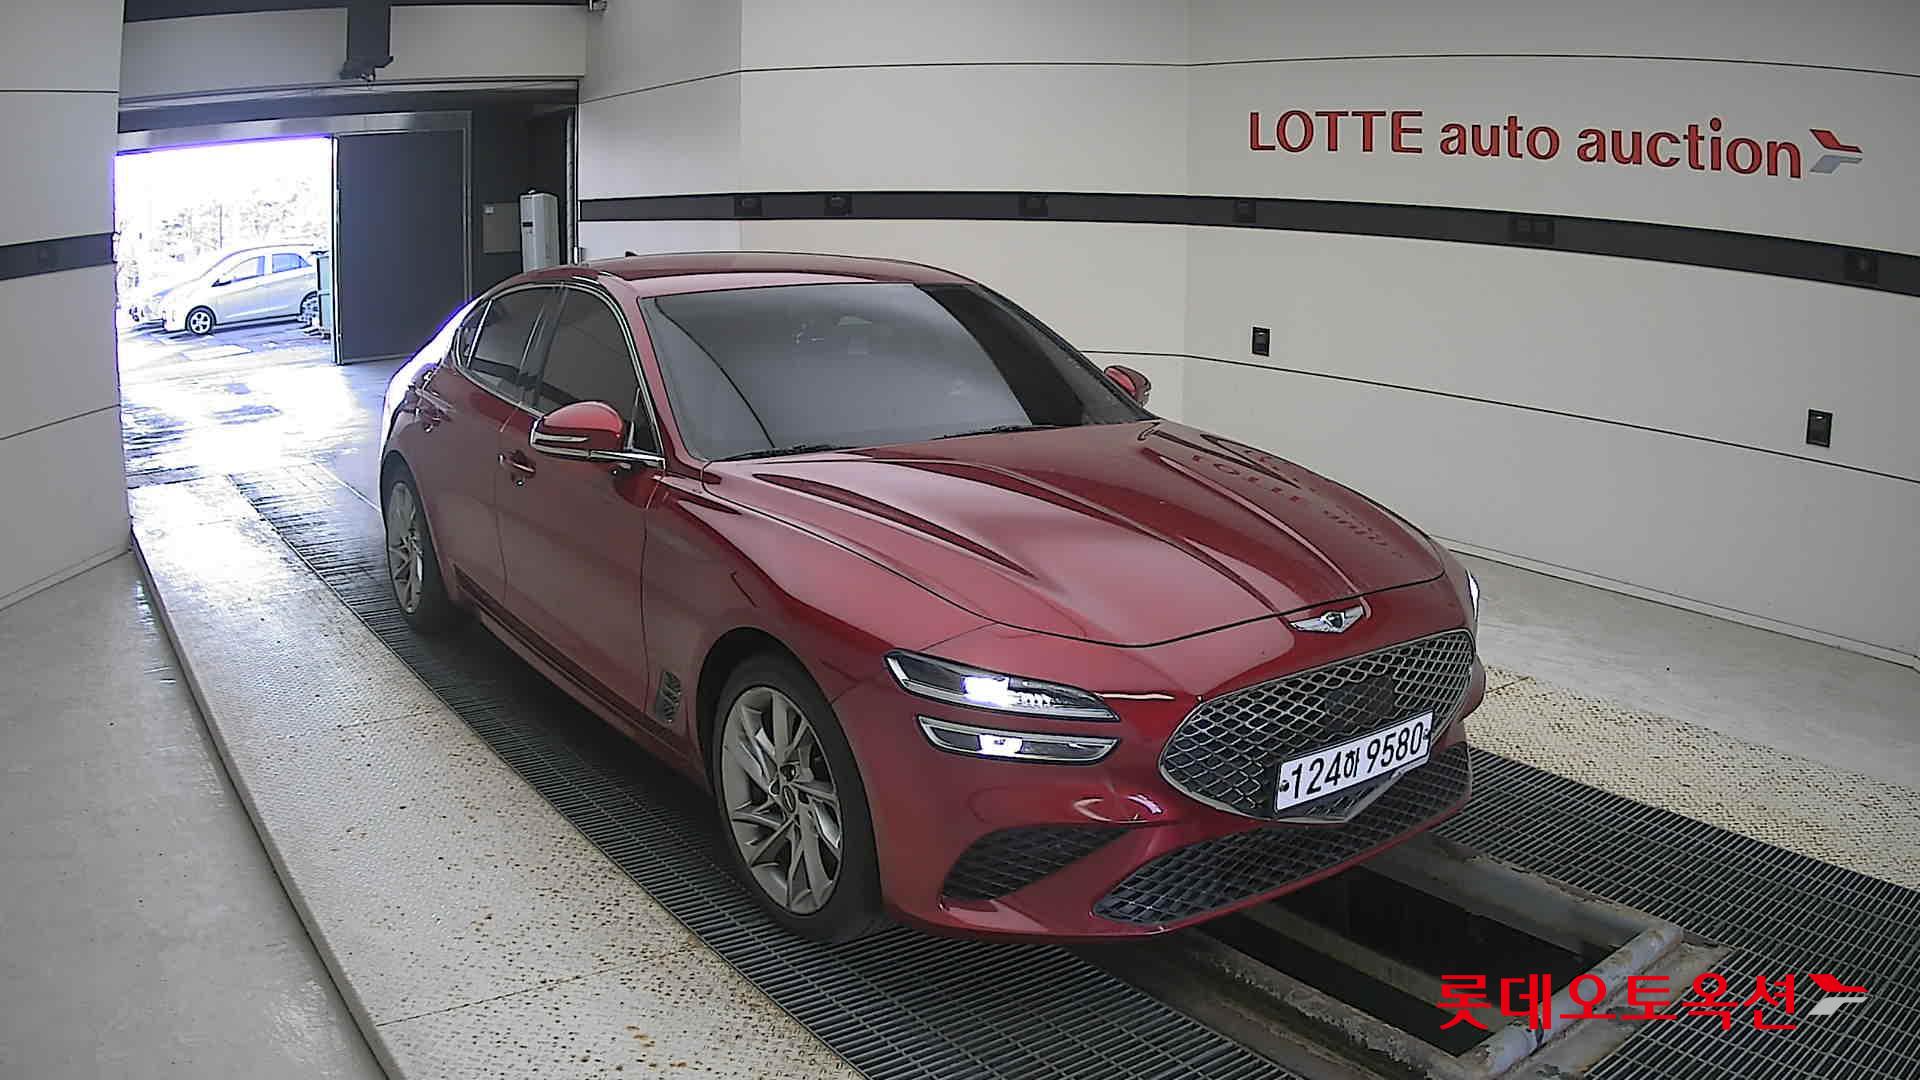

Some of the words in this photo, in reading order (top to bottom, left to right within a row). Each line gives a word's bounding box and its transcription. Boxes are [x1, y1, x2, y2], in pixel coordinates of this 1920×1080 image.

[1249, 110, 1424, 154] LOTTE
[1439, 115, 1561, 161] auto
[1576, 117, 1802, 179] auction
[1291, 747, 1361, 799] 124하
[1366, 721, 1424, 774] 9580
